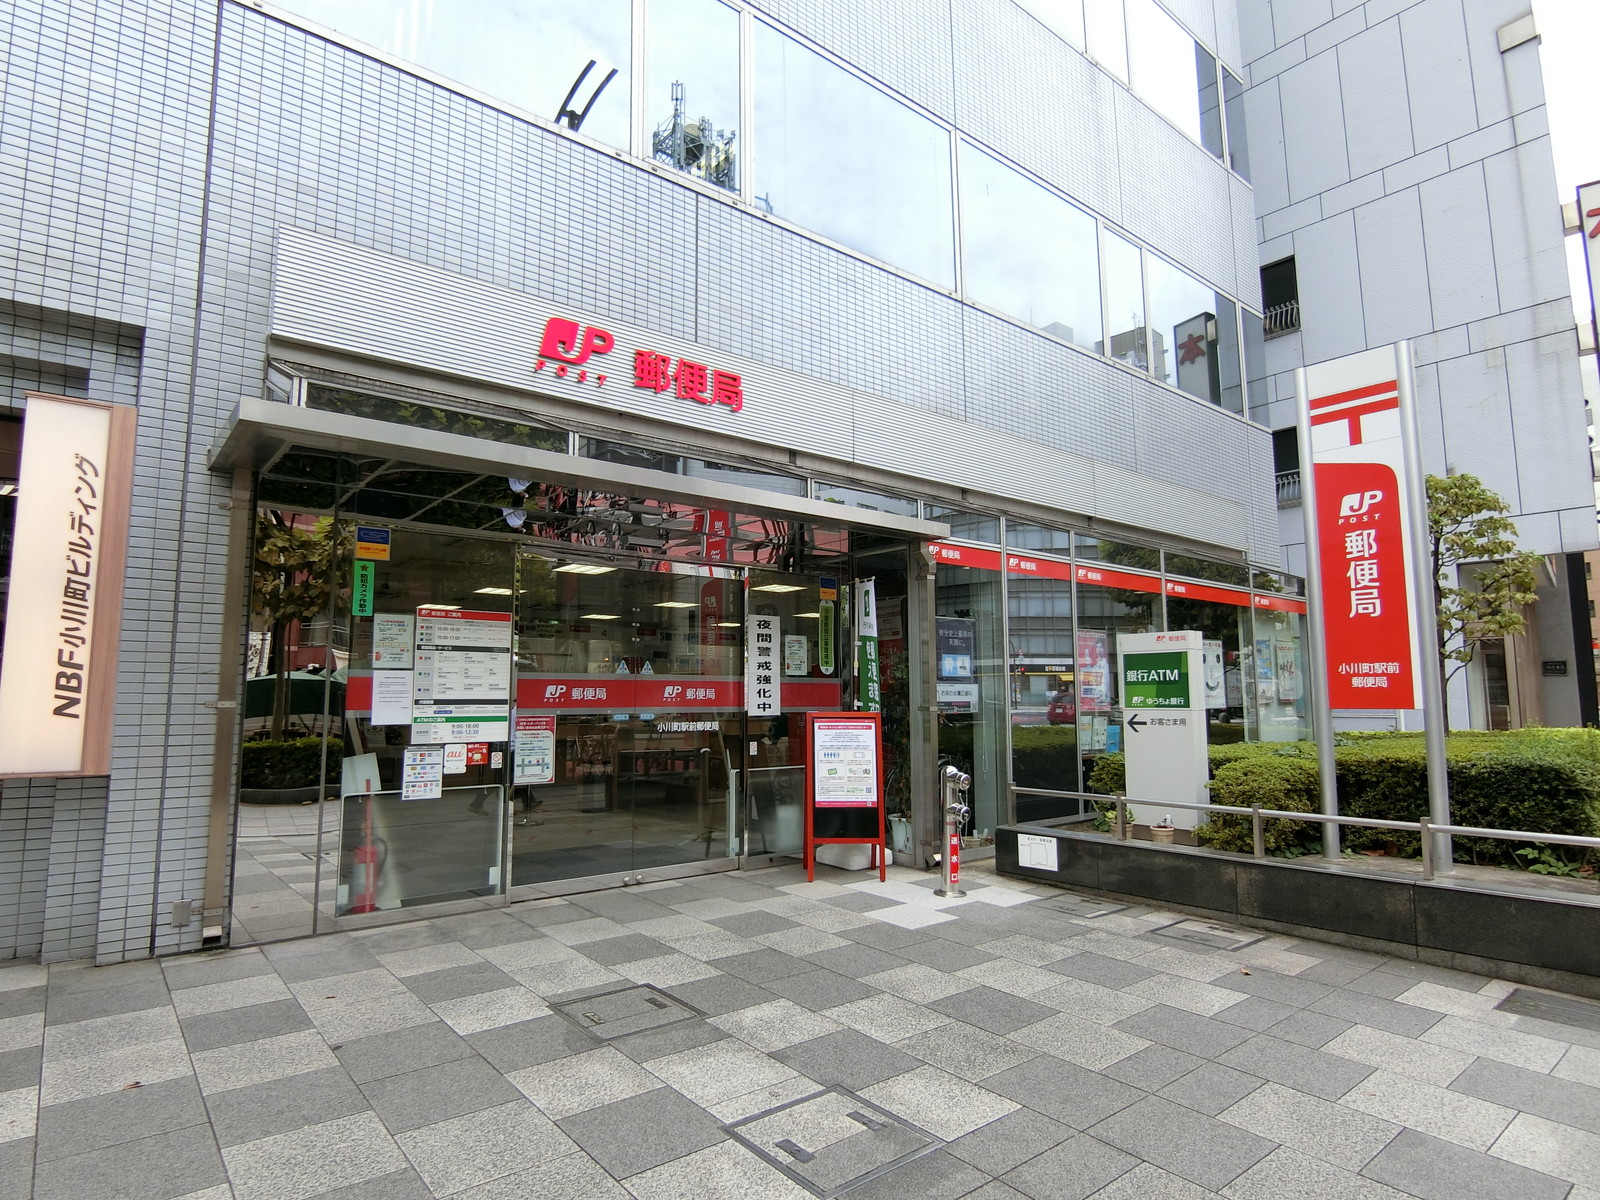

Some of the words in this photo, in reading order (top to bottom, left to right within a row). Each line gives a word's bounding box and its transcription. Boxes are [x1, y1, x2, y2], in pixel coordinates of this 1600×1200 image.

[539, 317, 615, 364] JP
[633, 349, 744, 413] 郵便局
[535, 359, 608, 387] POST
[1339, 490, 1383, 517] JP
[1338, 513, 1381, 525] POST
[941, 549, 961, 560] 郵便局
[1020, 560, 1037, 571] 郵便局
[1344, 528, 1381, 620] 郵便局
[52, 452, 100, 720] NBF小川町ビルディング
[358, 573, 369, 614] 防犯カメラ作動中
[756, 619, 773, 713] 夜間警戒強化中
[1337, 662, 1400, 675] 小川町駅前
[1126, 669, 1179, 682] 銀行ATM
[1351, 676, 1388, 688] 郵便局
[545, 685, 567, 698] JP
[571, 687, 607, 700] 郵便局
[664, 685, 682, 698] JP
[686, 687, 716, 700] 郵便局
[1146, 697, 1185, 706] ゆうちょ銀行
[657, 721, 720, 732] 小川町駅前郵便局
[1149, 718, 1187, 727] お客さま用
